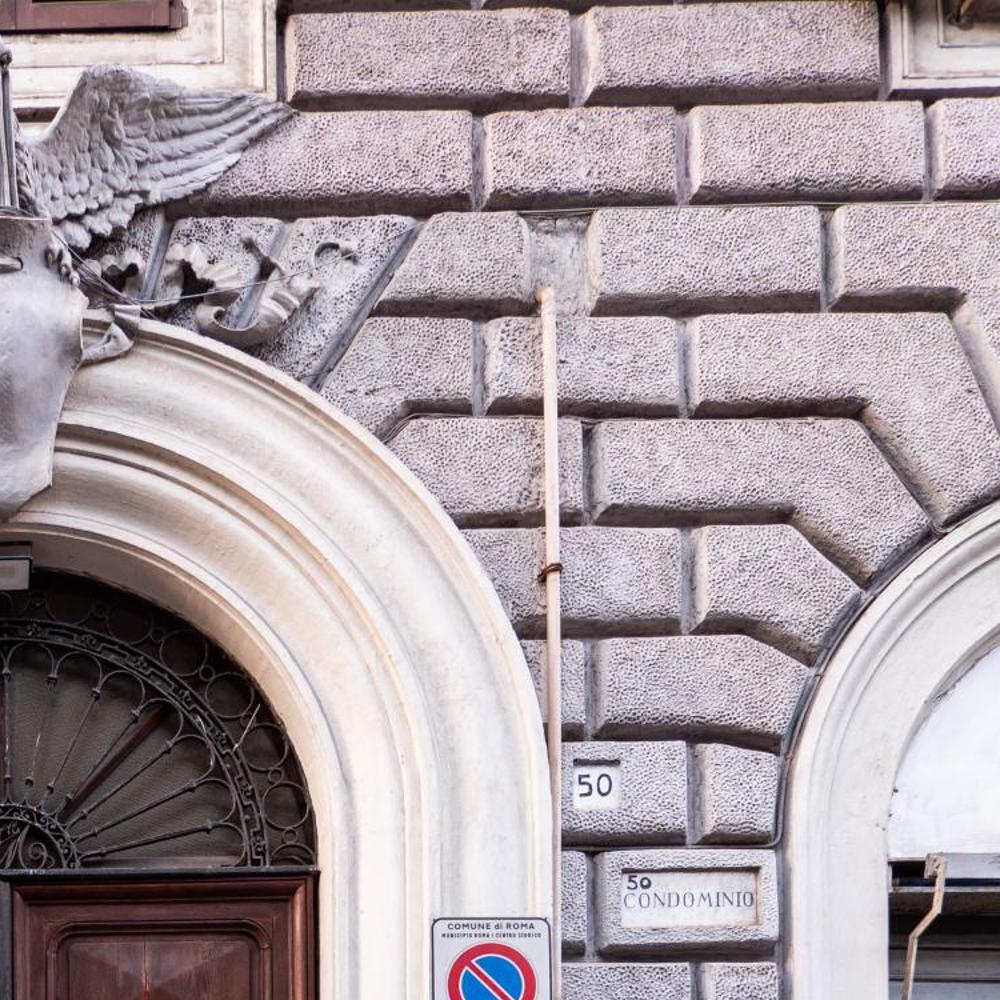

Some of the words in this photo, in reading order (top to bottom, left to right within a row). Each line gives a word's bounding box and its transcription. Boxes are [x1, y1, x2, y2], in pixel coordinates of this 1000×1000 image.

[577, 773, 613, 797] 50
[626, 875, 652, 890] 50
[623, 891, 754, 909] CONDOMINIO
[447, 922, 492, 930] COMUNE
[494, 922, 503, 930] di
[506, 922, 535, 930] ROMA
